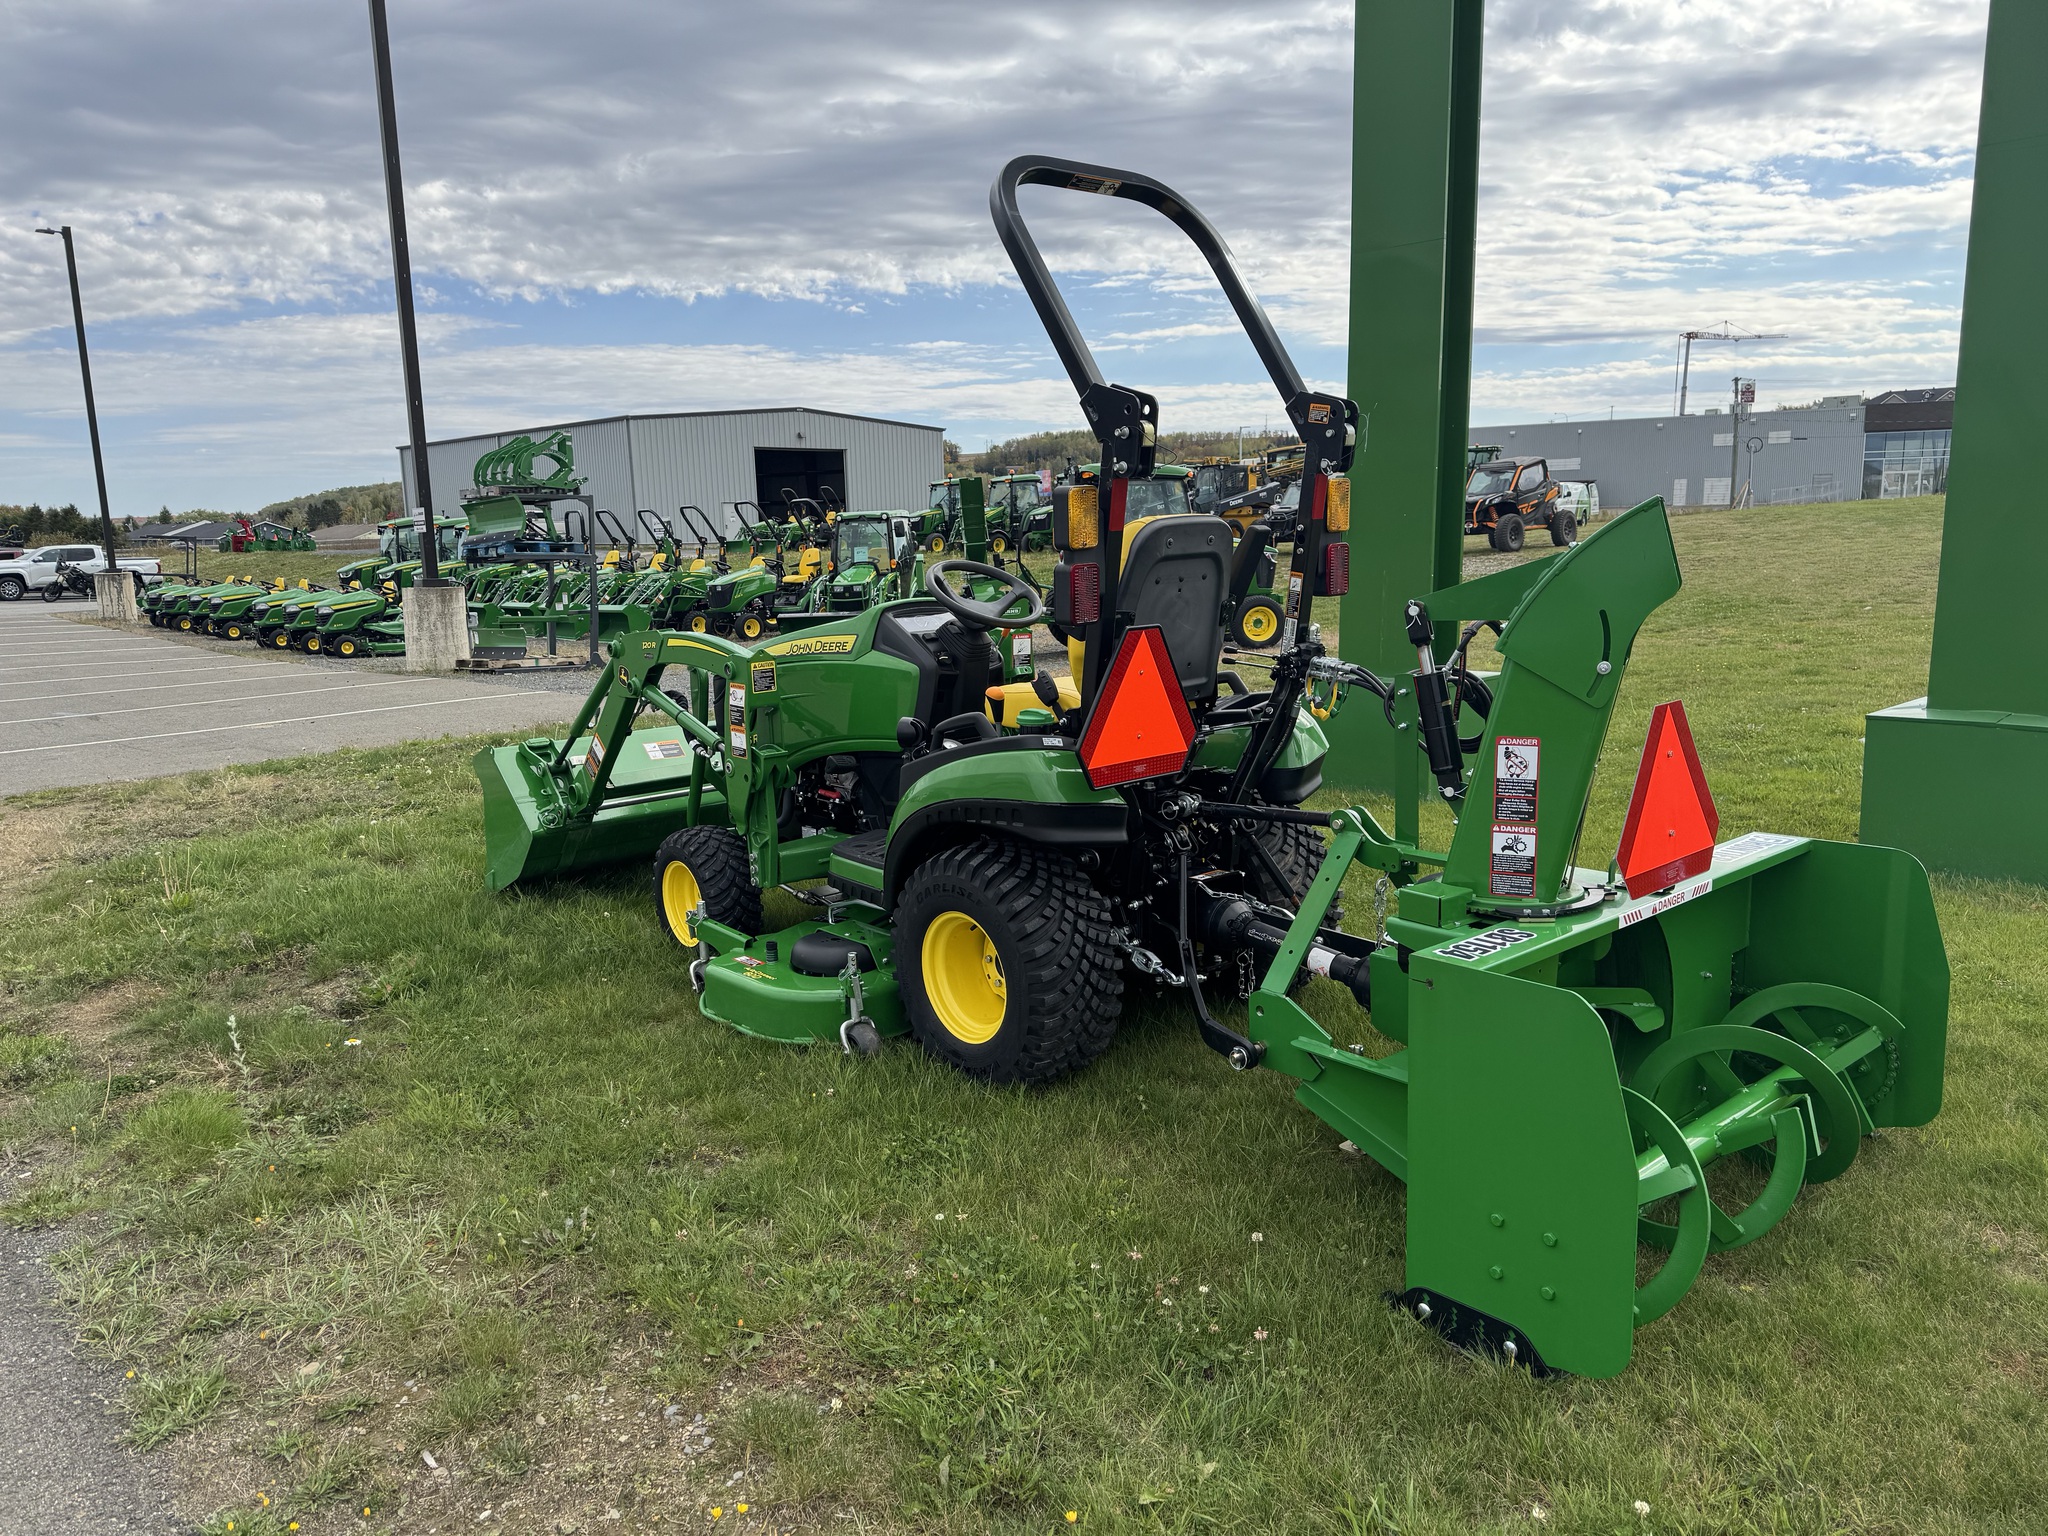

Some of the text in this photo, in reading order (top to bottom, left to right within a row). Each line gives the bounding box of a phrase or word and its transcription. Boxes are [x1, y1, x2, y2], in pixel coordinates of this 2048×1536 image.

[786, 640, 849, 655] JOHN DEERE
[1506, 738, 1538, 746] DANGER
[1500, 825, 1537, 834] DANGER
[1658, 891, 1686, 912] DANGER
[1435, 927, 1537, 961] SB1154
